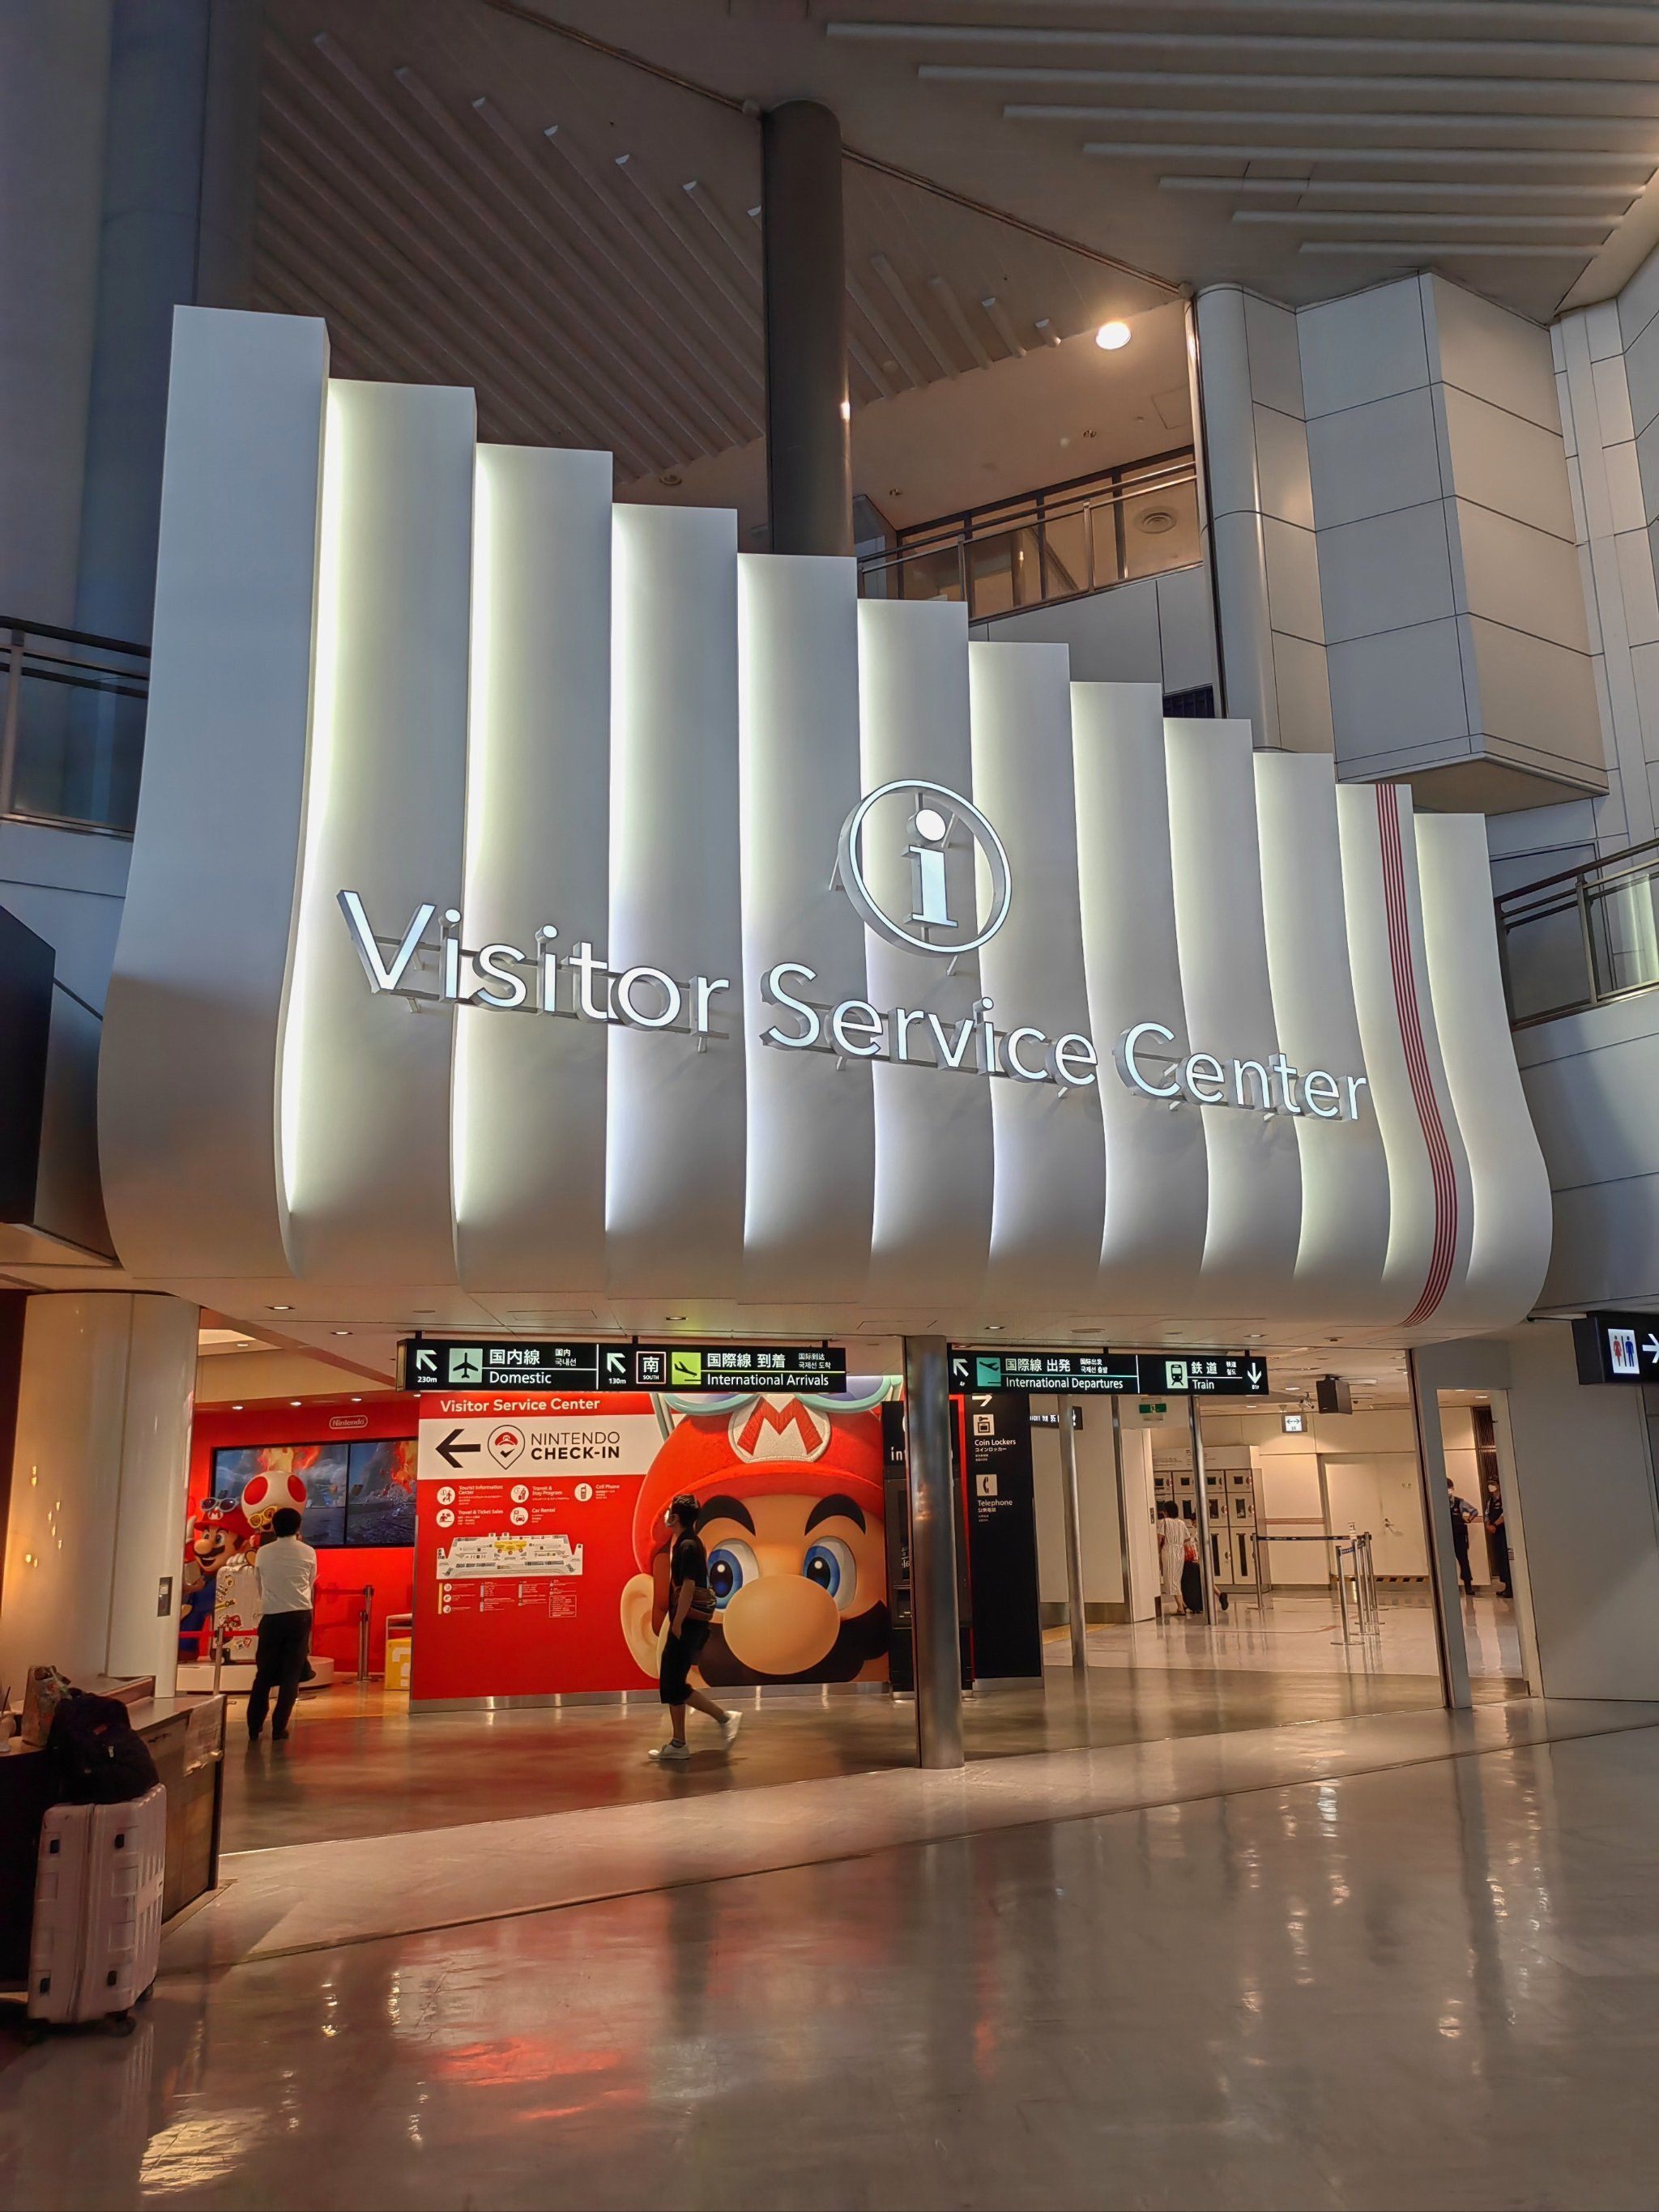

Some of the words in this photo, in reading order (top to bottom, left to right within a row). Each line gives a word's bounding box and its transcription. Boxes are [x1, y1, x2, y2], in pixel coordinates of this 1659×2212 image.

[336, 889, 730, 1034] Visitor
[760, 961, 1098, 1087] Service
[1115, 1022, 1367, 1121] Center
[489, 1349, 540, 1365] 国内線
[555, 1348, 571, 1357] 国内
[555, 1357, 577, 1366] 국내선
[643, 1357, 659, 1374] 南
[707, 1353, 751, 1368] 国際線
[757, 1354, 786, 1369] 到着
[1005, 1358, 1042, 1371] 国際線
[1047, 1359, 1070, 1372] 出発
[1192, 1362, 1218, 1375] 鉄道
[489, 1371, 552, 1383] Domestic
[707, 1374, 783, 1385] International
[787, 1375, 829, 1386] Arrivals
[1006, 1378, 1068, 1388] International
[1072, 1379, 1123, 1390] Departures
[1192, 1379, 1214, 1389] Train
[441, 1400, 489, 1413] Visitor
[493, 1399, 547, 1411] Service
[551, 1397, 600, 1410] Center
[332, 1417, 366, 1428] Nintendo
[531, 1431, 621, 1446] NINTENDO
[531, 1446, 620, 1460] CHECK-IN
